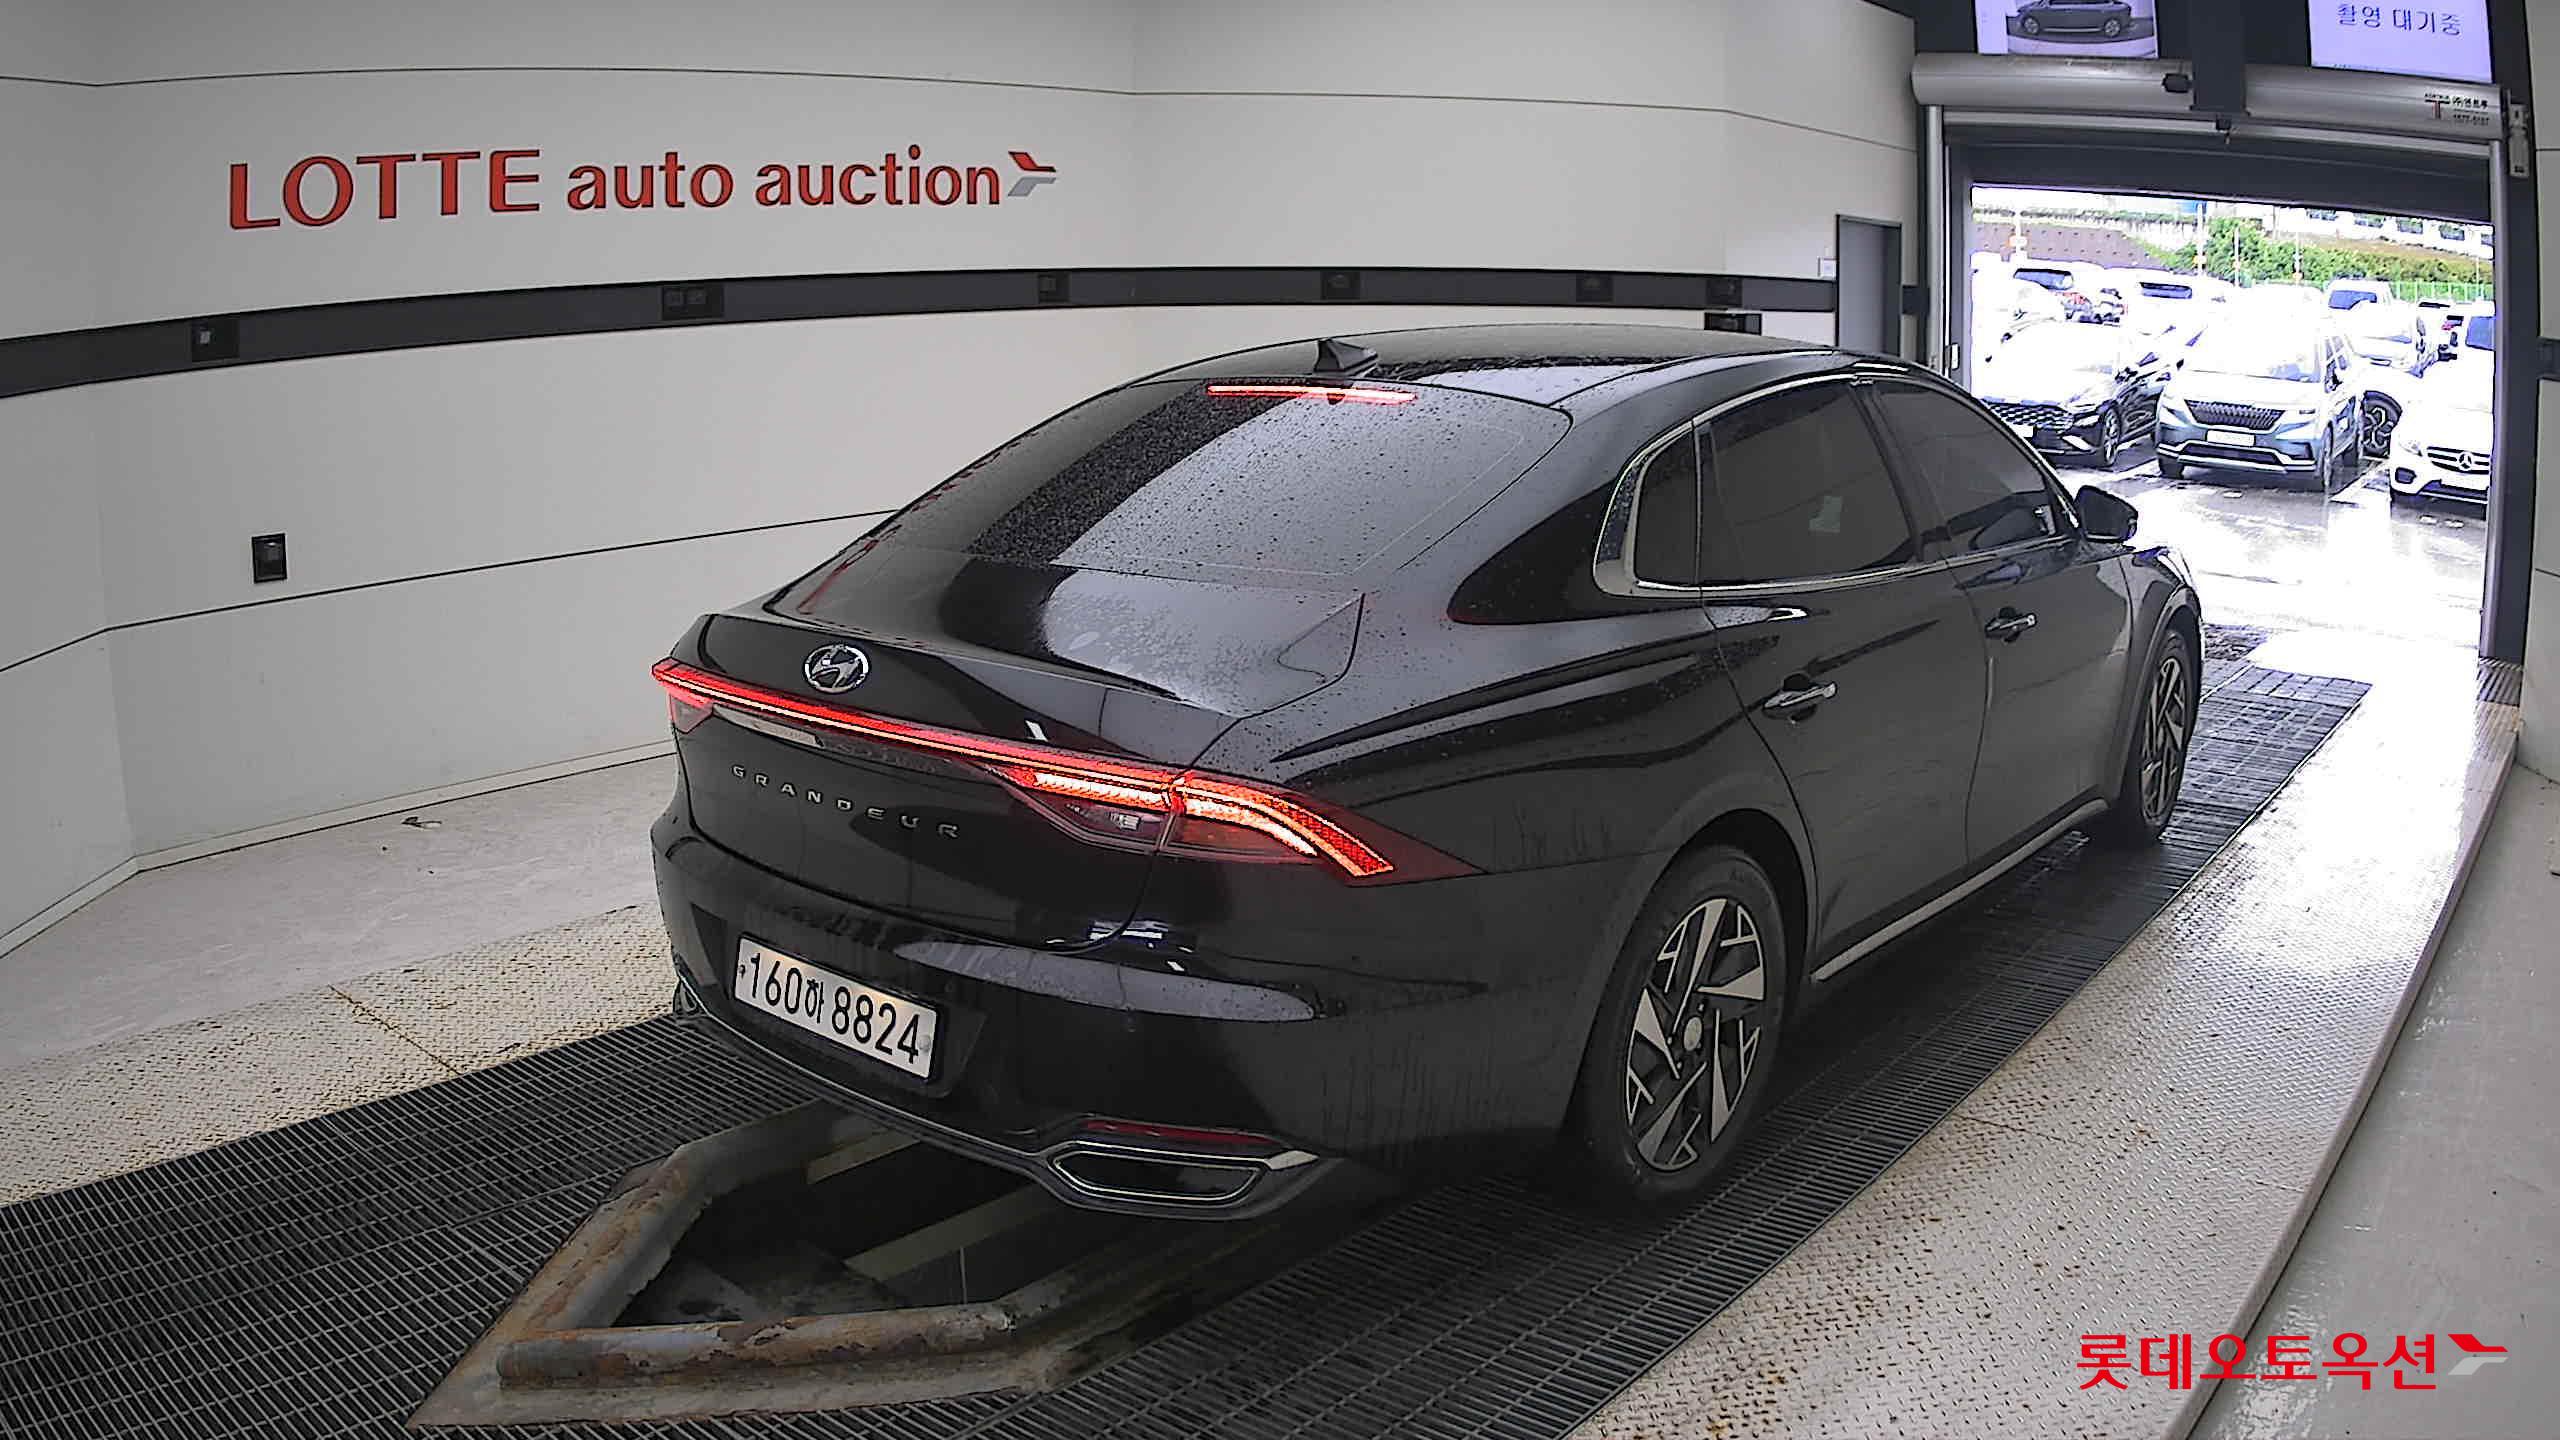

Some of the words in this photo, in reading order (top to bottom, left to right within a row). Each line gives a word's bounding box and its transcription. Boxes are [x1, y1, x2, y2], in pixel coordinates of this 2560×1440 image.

[2338, 4, 2381, 28] 촬영
[2393, 8, 2461, 36] 대기중
[229, 149, 542, 231] LOTTE
[566, 151, 734, 209] auto
[755, 144, 1001, 207] auction
[732, 765, 959, 839] GRANDEUR
[831, 986, 921, 1065] 8824
